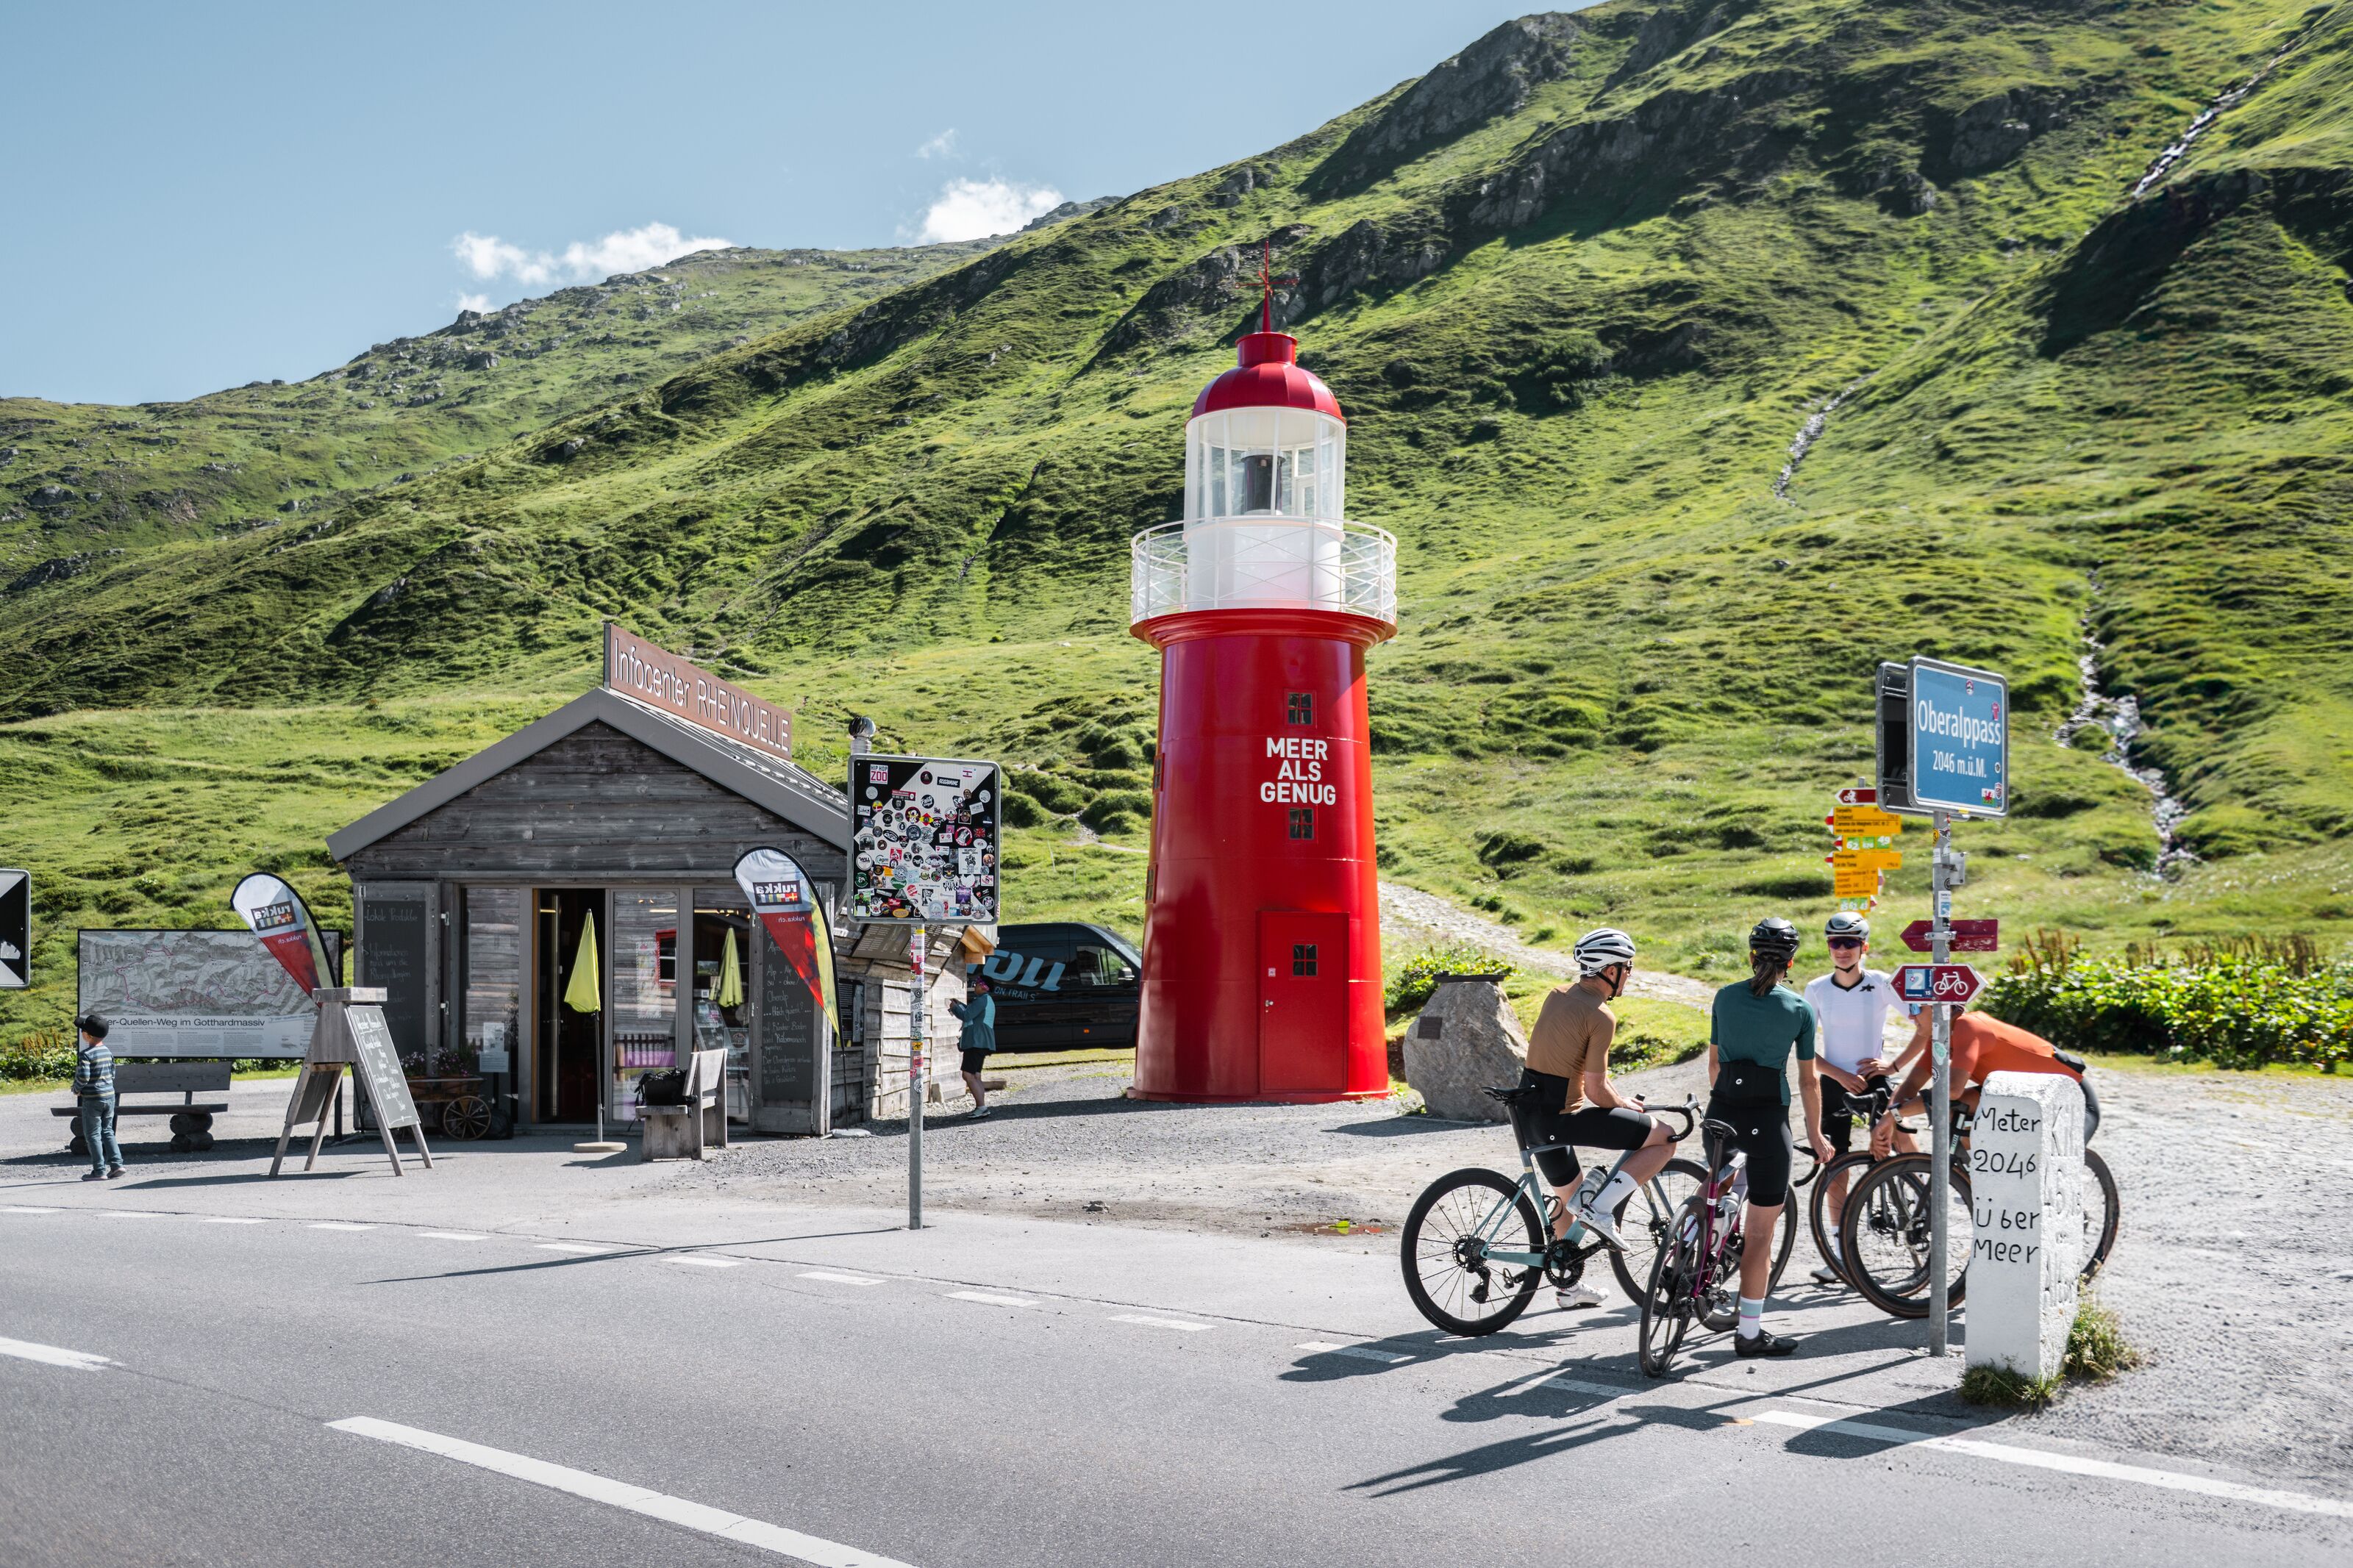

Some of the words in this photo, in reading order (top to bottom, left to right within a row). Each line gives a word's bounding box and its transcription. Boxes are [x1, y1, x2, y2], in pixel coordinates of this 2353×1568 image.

[615, 638, 690, 709] Infocenter
[698, 679, 789, 752] RHEINQUELLE
[1918, 700, 2002, 749] Oberalppass
[1266, 737, 1328, 761] MEER
[871, 771, 888, 781] ZOO
[1277, 759, 1321, 781] ALS
[1932, 750, 1954, 773] 2046
[1957, 756, 1987, 778] m.ü.M.
[1260, 781, 1336, 806] GENUG
[1846, 840, 1860, 851] 62
[1877, 836, 1891, 845] 49
[1910, 973, 1924, 989] 2
[108, 1018, 177, 1028] er-Quellen-Weg
[193, 1018, 265, 1026] Gotthardmassiv
[1974, 1107, 2041, 1133] Meter
[1974, 1149, 2036, 1179] 2046
[1974, 1239, 2039, 1264] Meer
